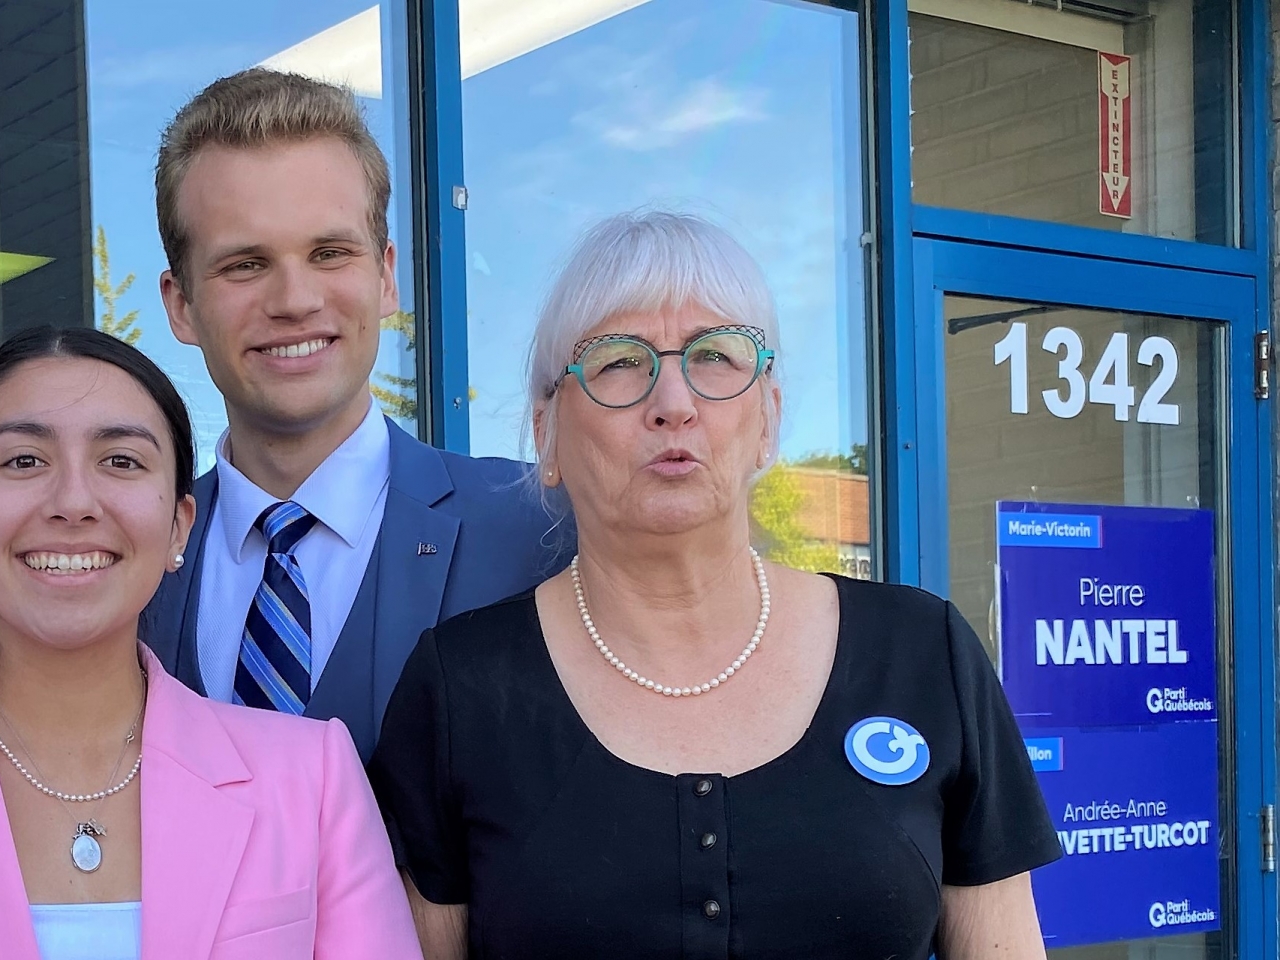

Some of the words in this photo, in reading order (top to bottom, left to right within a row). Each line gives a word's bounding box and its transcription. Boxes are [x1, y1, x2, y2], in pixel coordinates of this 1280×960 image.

[1110, 69, 1120, 201] EXTINCTEUR
[993, 321, 1180, 426] 1342
[1008, 520, 1091, 538] Marie-Victorin
[1079, 577, 1145, 607] Pierre
[1035, 618, 1189, 666] NANTEL
[1163, 687, 1187, 700] Parti
[1163, 697, 1213, 712] Québécois
[1063, 798, 1167, 823] Andrée-Anne
[1166, 898, 1189, 913] Parti
[1166, 909, 1215, 925] Québécois
